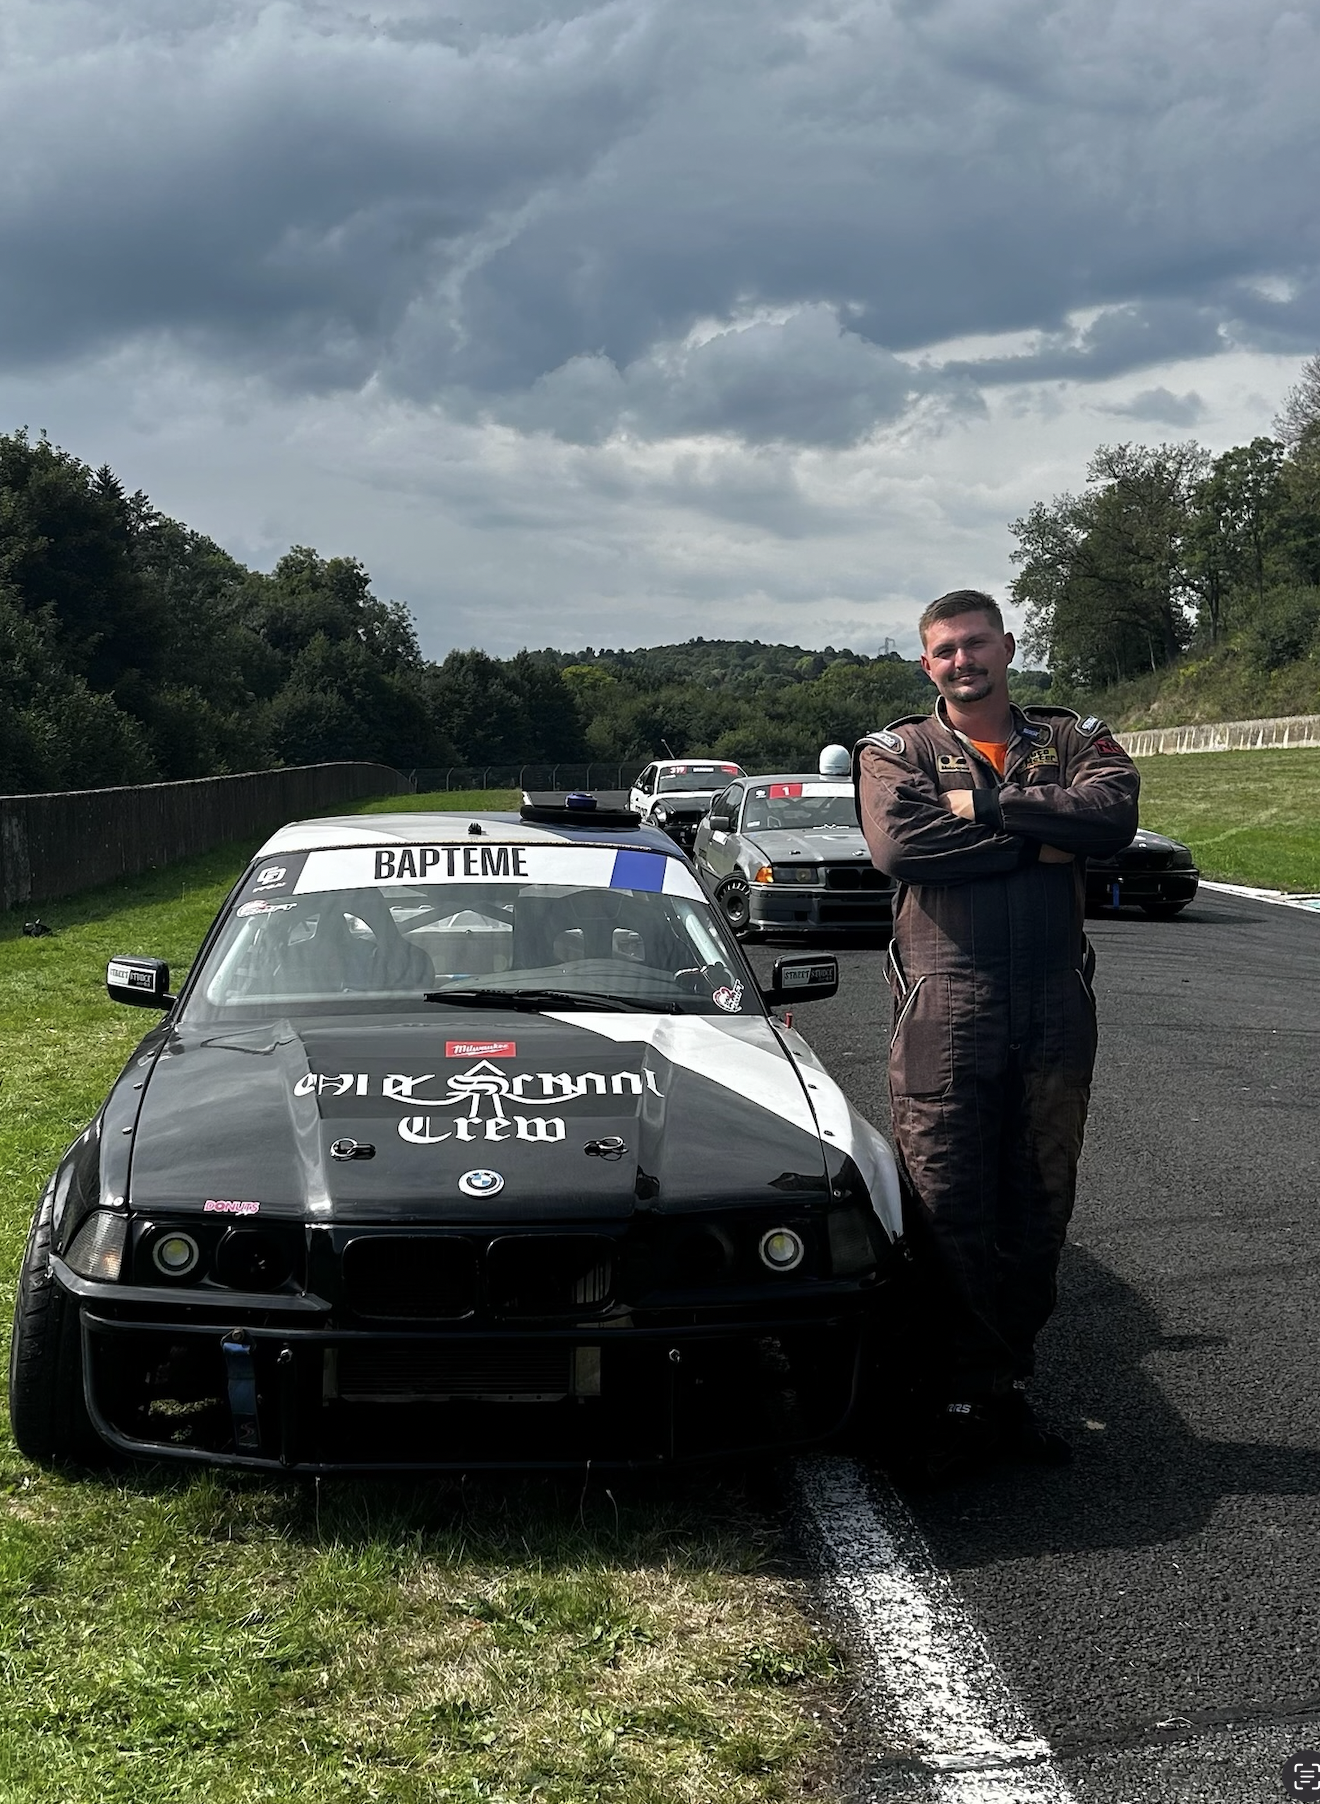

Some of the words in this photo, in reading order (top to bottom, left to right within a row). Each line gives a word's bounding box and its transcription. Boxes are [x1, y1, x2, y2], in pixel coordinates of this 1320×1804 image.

[782, 786, 790, 796] 1
[374, 847, 529, 880] BAPTEME
[785, 970, 809, 979] STREET
[452, 1043, 509, 1055] Milwaukee
[397, 1115, 566, 1144] Crew
[204, 1200, 260, 1213] DONUTS
